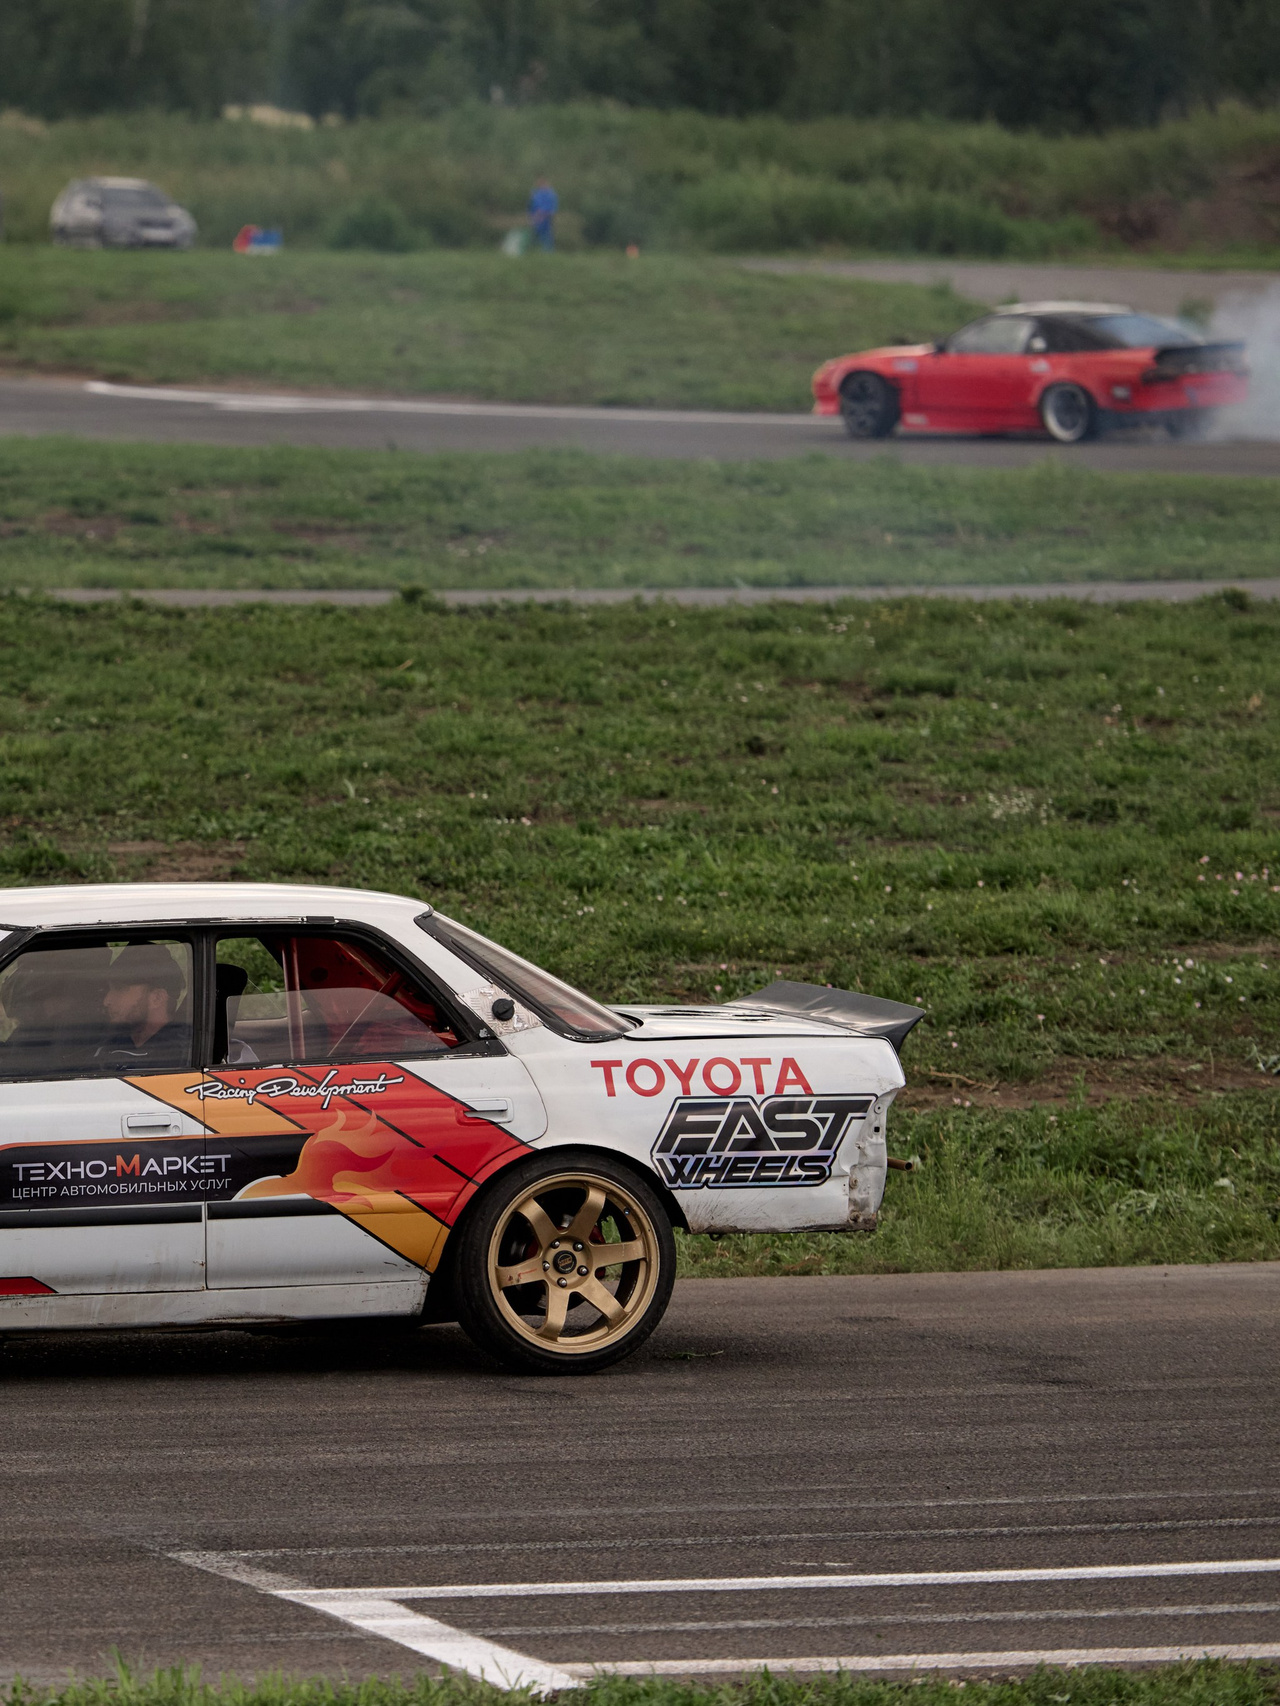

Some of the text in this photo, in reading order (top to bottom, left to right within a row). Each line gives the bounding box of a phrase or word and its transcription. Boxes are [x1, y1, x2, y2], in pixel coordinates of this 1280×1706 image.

[185, 1077, 257, 1105] Racing
[590, 1056, 815, 1098] TOYOTA
[12, 1154, 232, 1182] ТЕХНО-МАРКЕТ
[656, 1154, 832, 1183] WHEELS
[12, 1178, 232, 1199] ЦЕНТР АВТОМОБИЛЬНЫХ УСЛУГ
